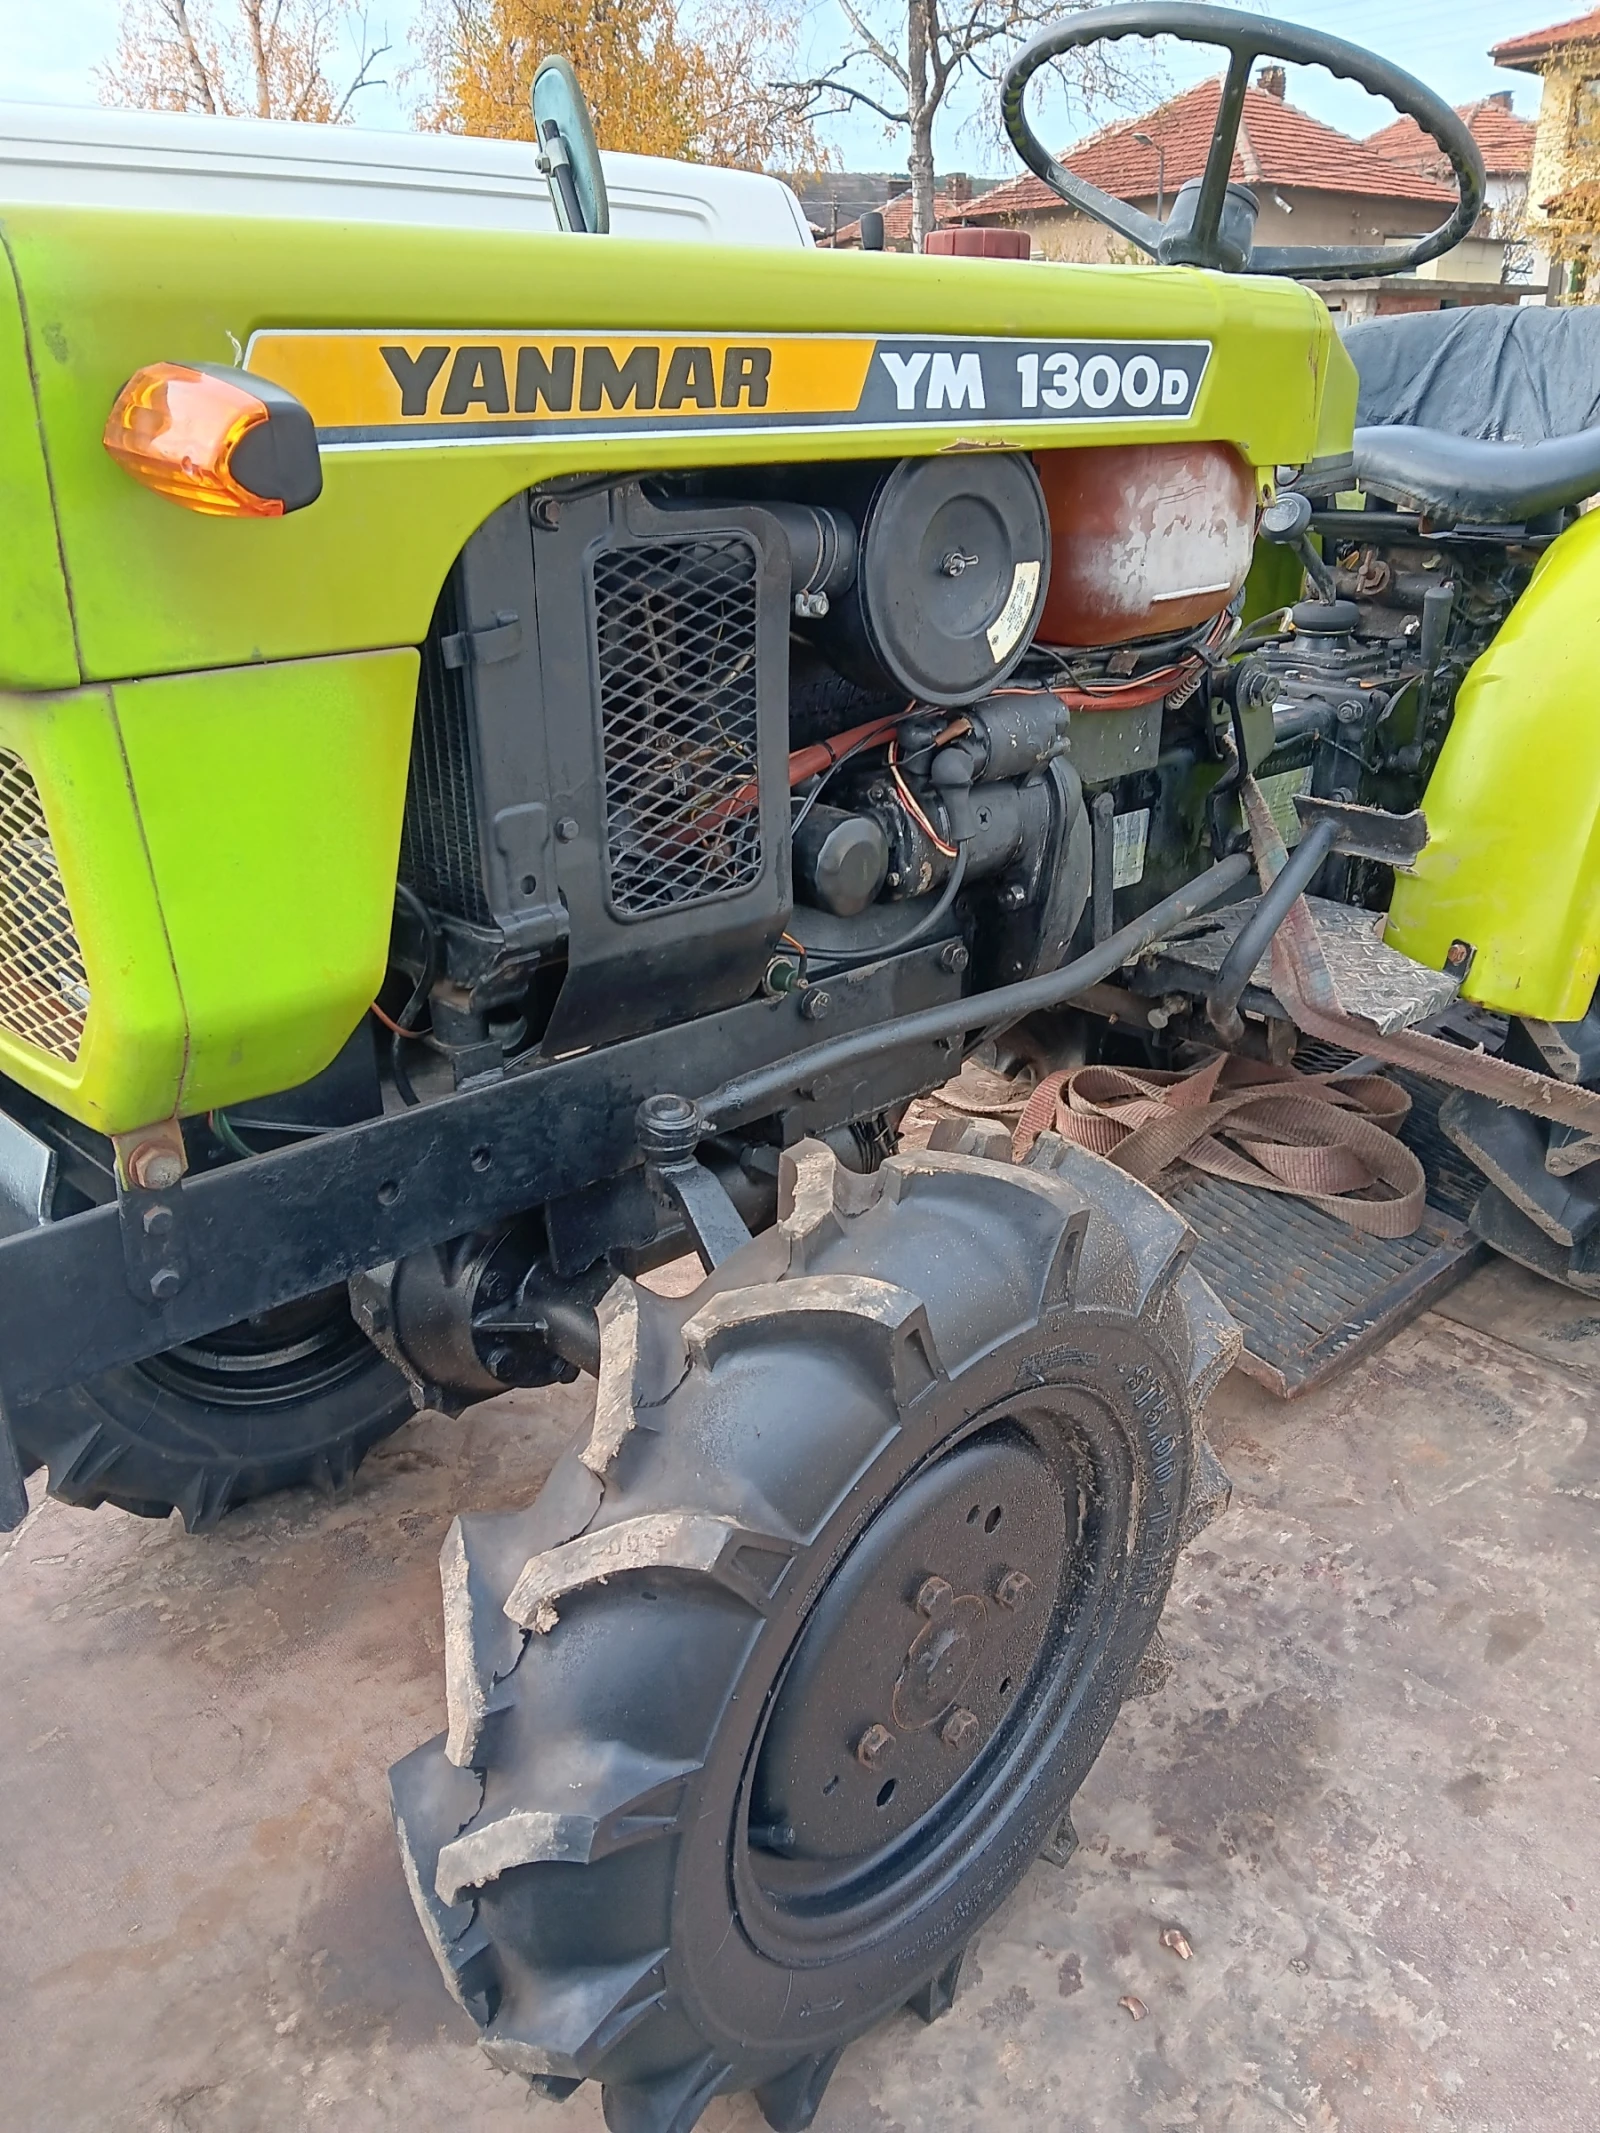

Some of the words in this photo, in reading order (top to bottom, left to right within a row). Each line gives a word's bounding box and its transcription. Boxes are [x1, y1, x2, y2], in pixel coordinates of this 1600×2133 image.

[379, 346, 771, 416] YANMAR
[879, 352, 986, 410] YM
[1016, 352, 1190, 409] 1300D
